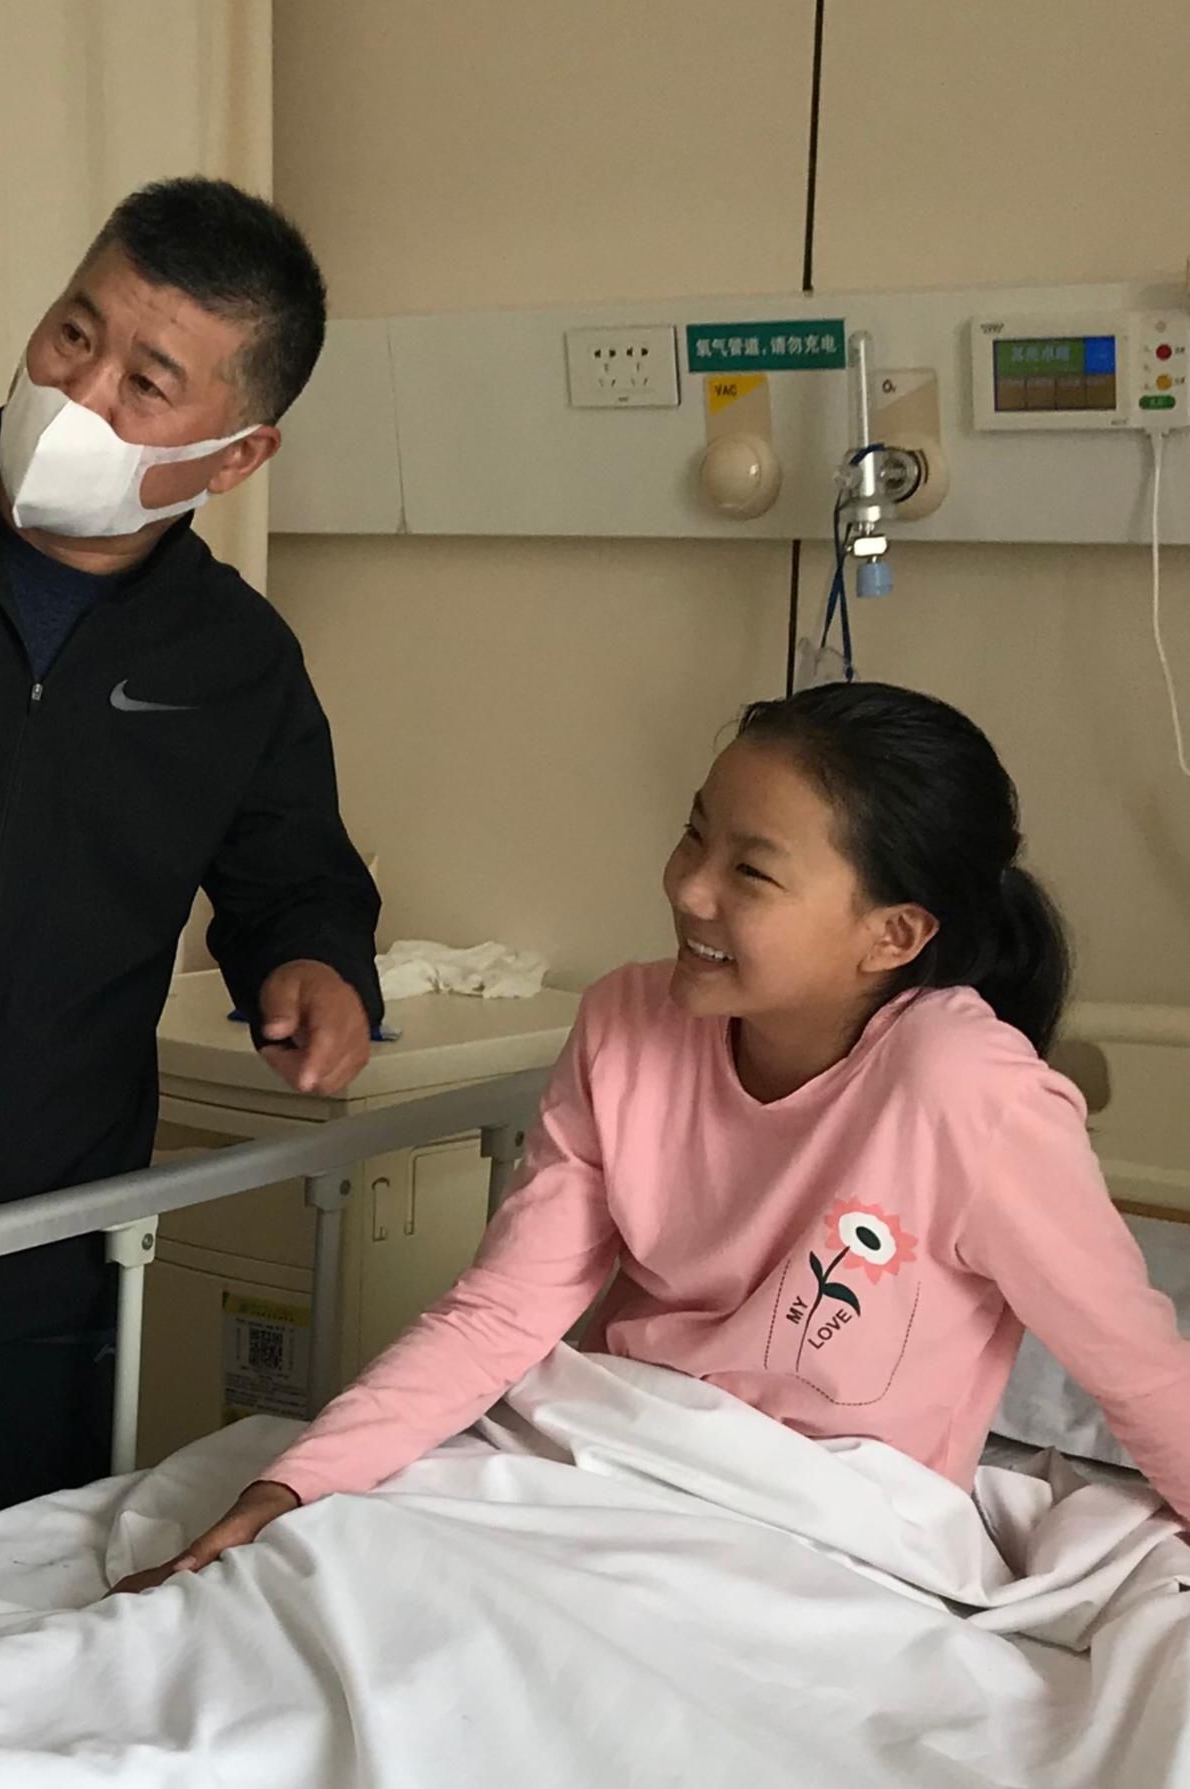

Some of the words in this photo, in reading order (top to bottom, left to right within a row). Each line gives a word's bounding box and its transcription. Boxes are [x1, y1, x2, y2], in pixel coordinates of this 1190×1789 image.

[714, 384, 738, 397] VAC
[786, 1296, 808, 1324] MY
[807, 1308, 852, 1350] LOVE
